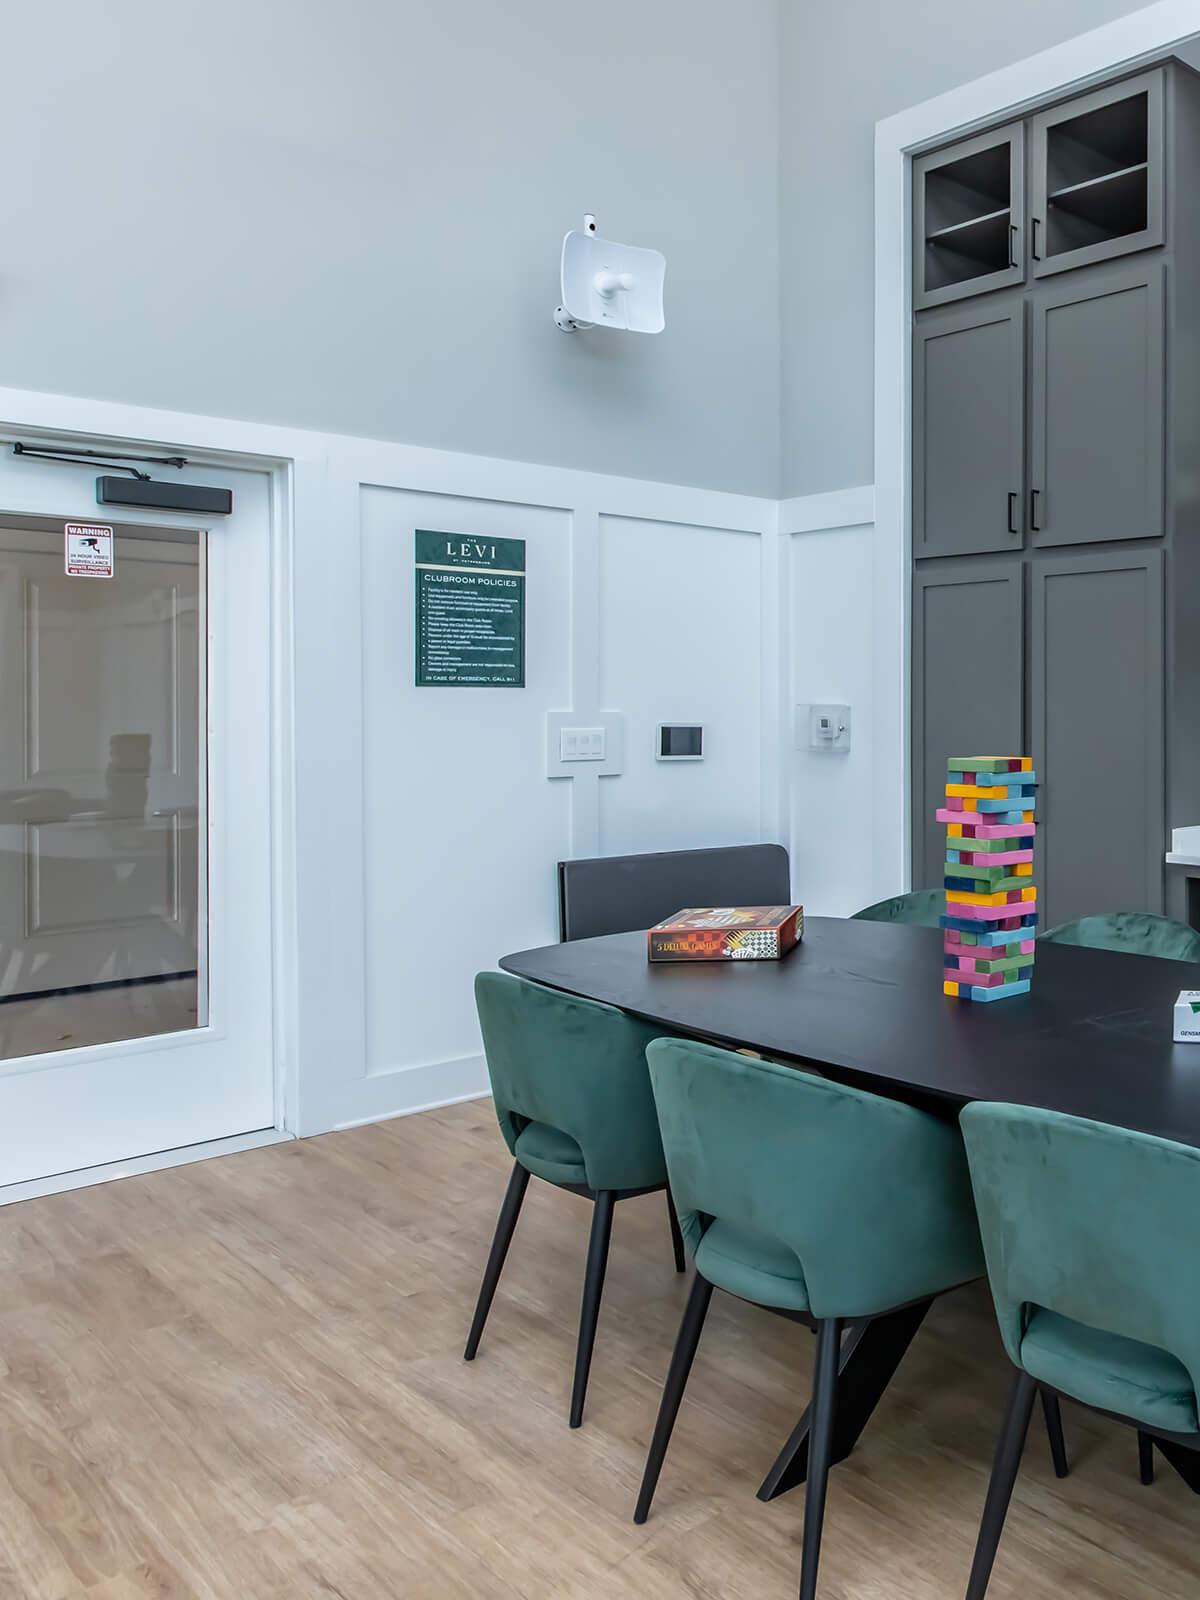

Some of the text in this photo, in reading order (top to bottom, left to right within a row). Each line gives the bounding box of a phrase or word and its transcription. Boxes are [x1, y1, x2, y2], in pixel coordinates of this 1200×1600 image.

[69, 527, 109, 536] WARNING
[447, 542, 496, 559] LEVI
[424, 574, 517, 587] CLUBROOM POLICIES
